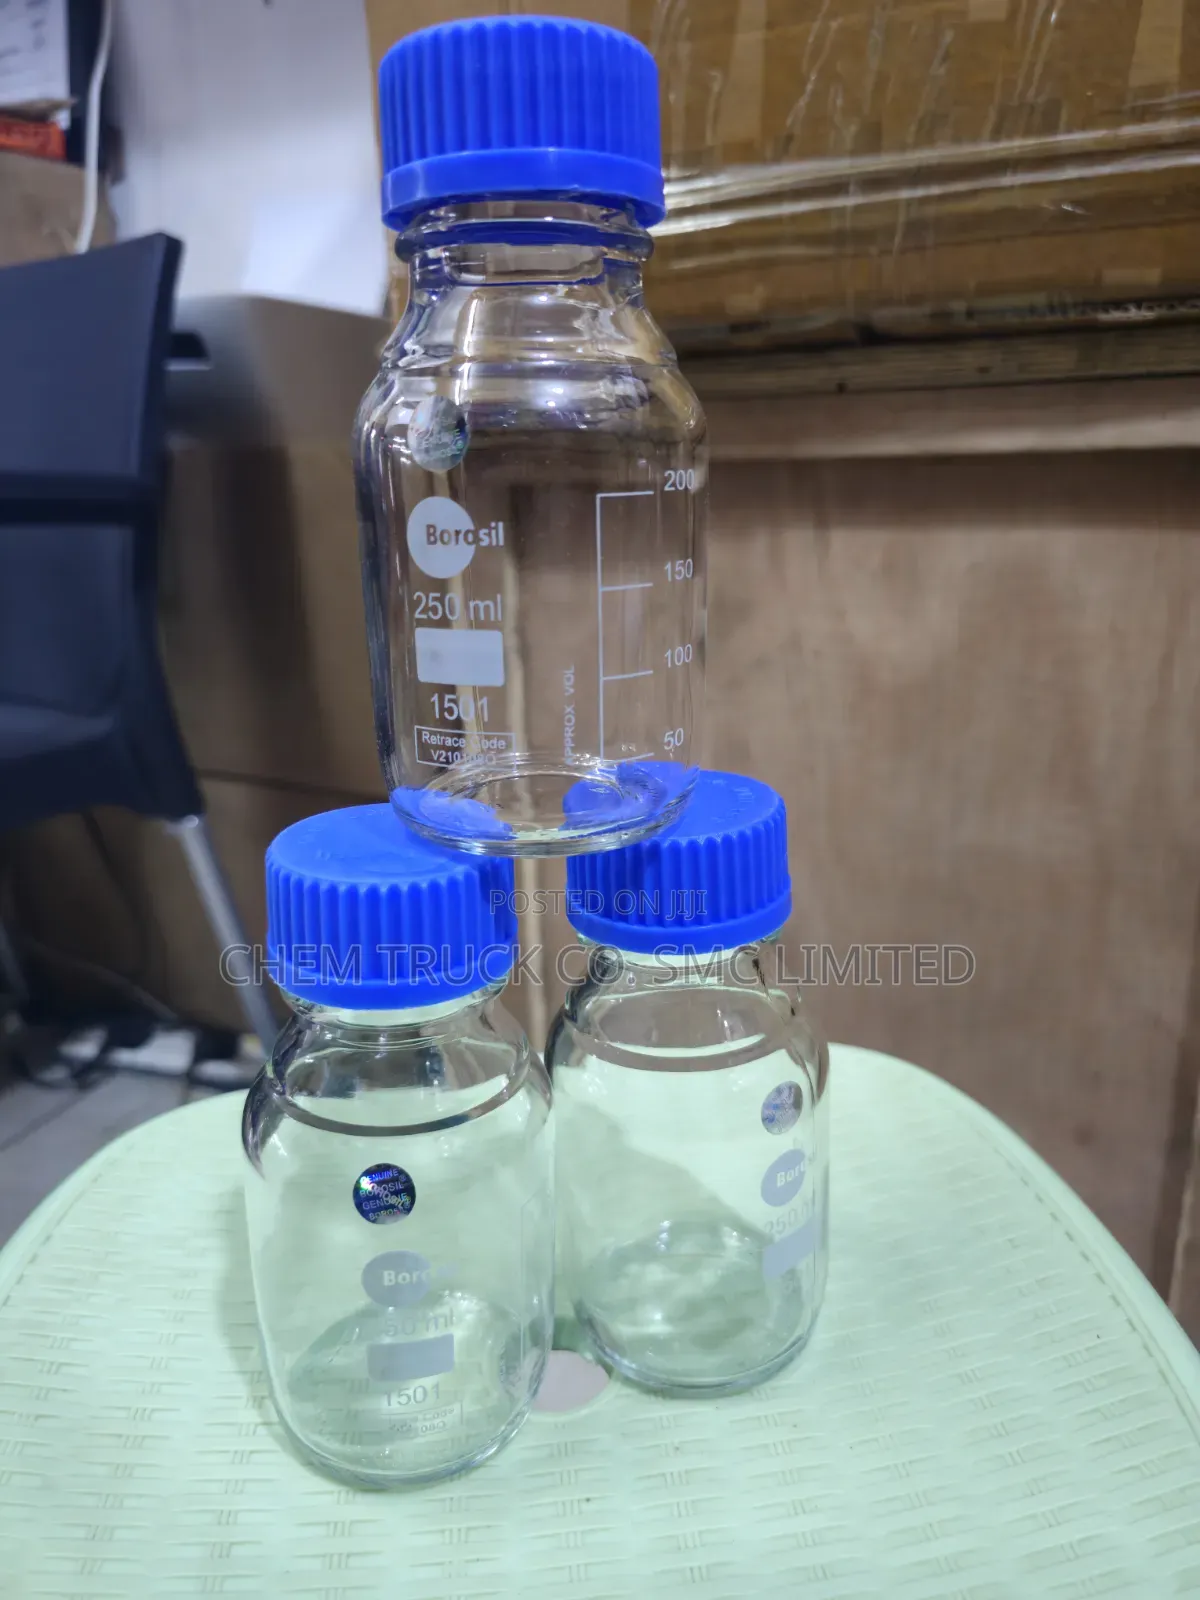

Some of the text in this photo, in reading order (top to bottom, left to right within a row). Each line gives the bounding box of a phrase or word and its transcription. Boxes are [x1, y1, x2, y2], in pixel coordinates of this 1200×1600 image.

[664, 469, 695, 492] 200
[425, 521, 505, 547] Borosil
[664, 558, 694, 582] 150
[413, 591, 502, 621] 250 ml
[664, 643, 693, 668] 100
[563, 664, 575, 696] VOL
[430, 692, 488, 722] 1501
[421, 730, 466, 748] Retrace
[663, 727, 684, 750] 50
[384, 1380, 440, 1407] 1501
